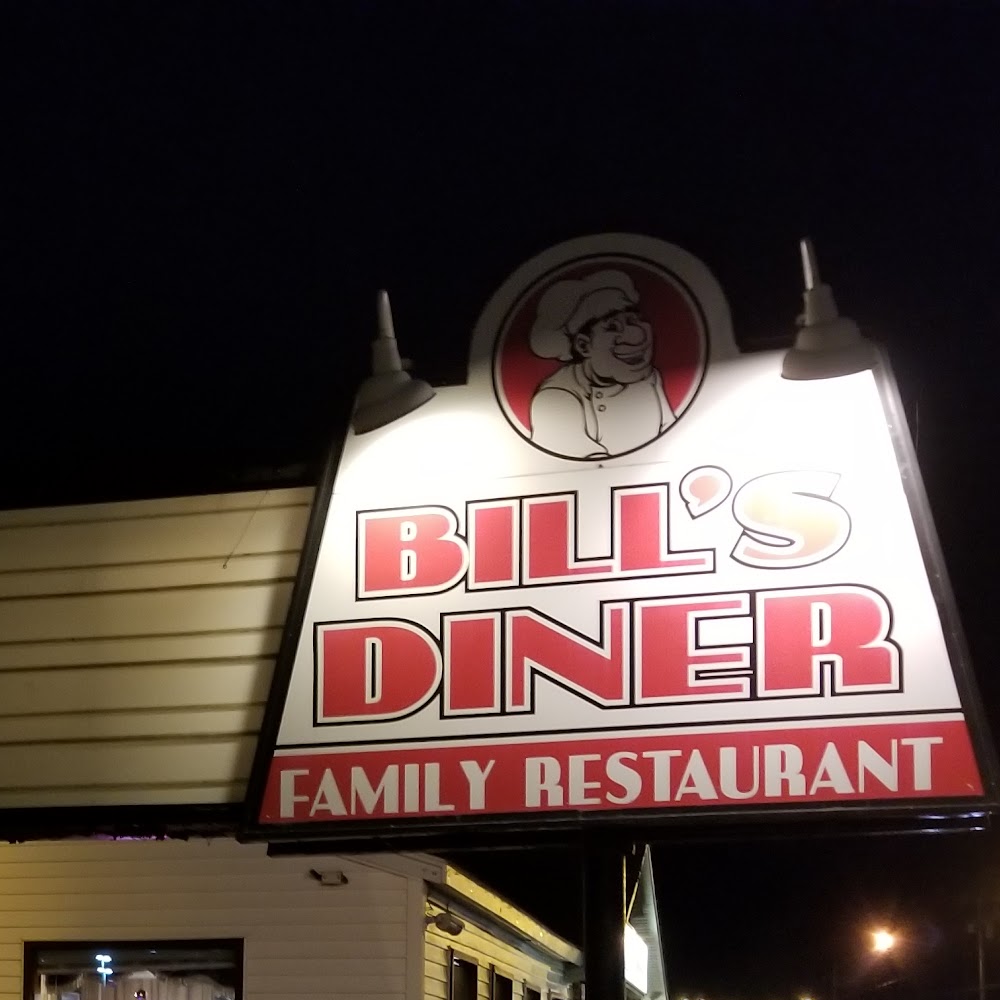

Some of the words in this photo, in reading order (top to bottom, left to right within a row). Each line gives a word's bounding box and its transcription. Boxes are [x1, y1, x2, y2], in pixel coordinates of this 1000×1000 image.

[356, 465, 851, 600] BILL'S
[314, 584, 904, 726] DINER
[280, 759, 496, 818] FAMILY
[525, 737, 943, 806] RESTAURANT
